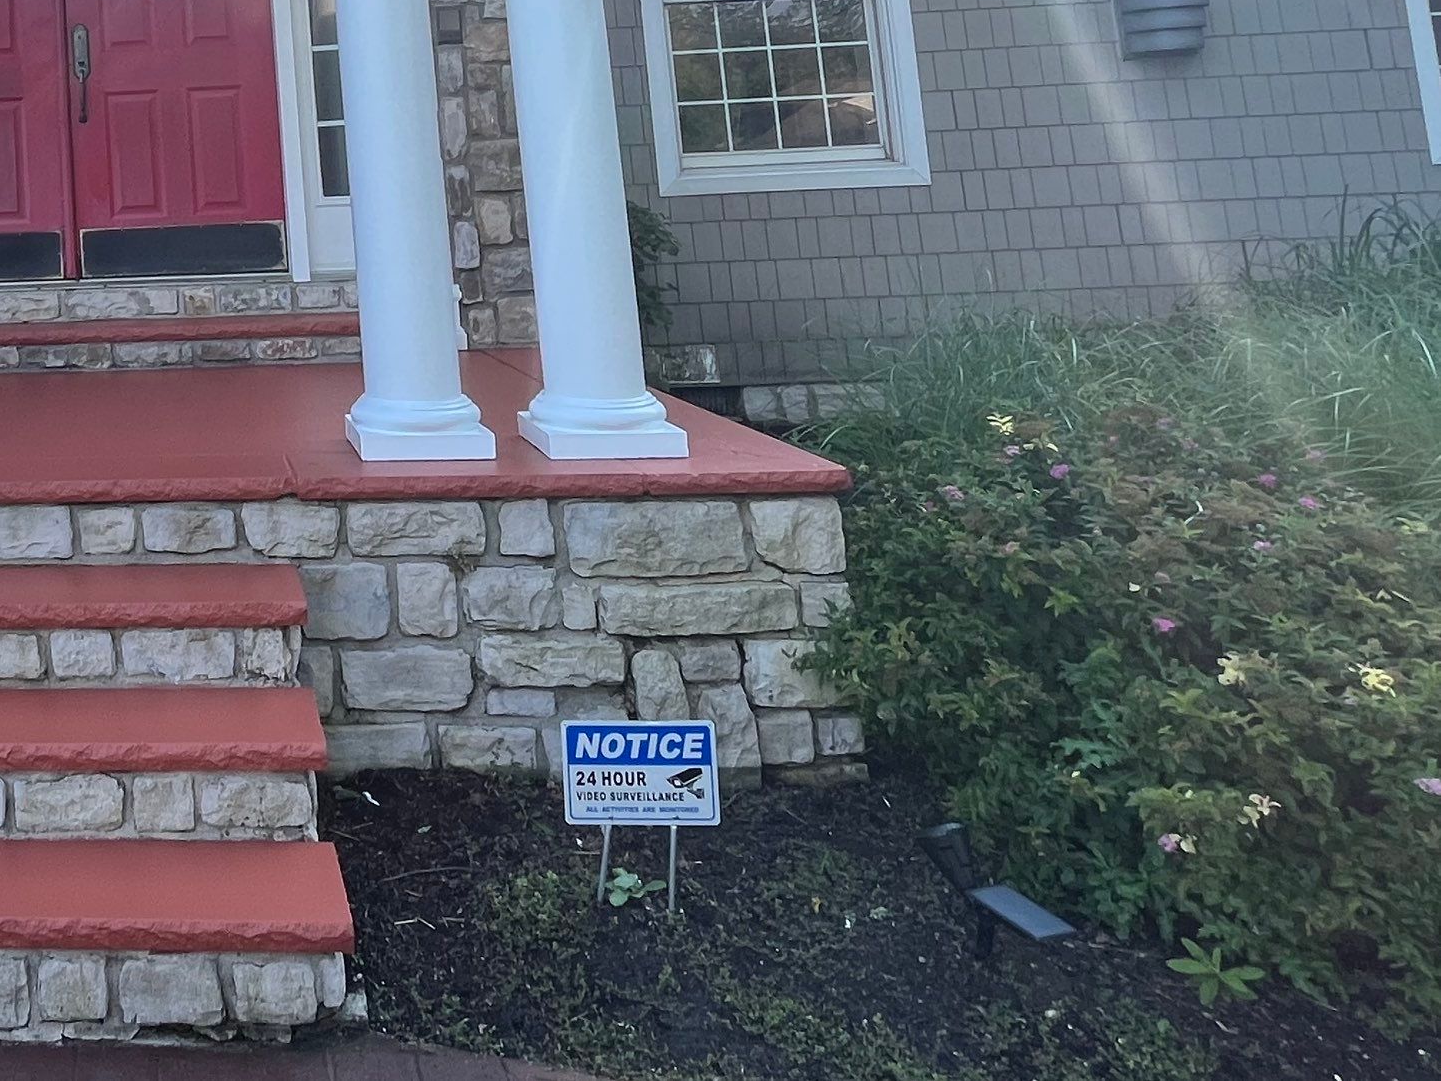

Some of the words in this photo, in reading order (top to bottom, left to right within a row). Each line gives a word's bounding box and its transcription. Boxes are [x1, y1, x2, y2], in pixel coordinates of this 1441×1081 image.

[575, 732, 705, 759] NOTICE
[576, 771, 597, 786] 24
[602, 771, 647, 786] HOUR
[576, 791, 607, 801] VIDEO
[610, 791, 684, 801] SURVEILLANCE
